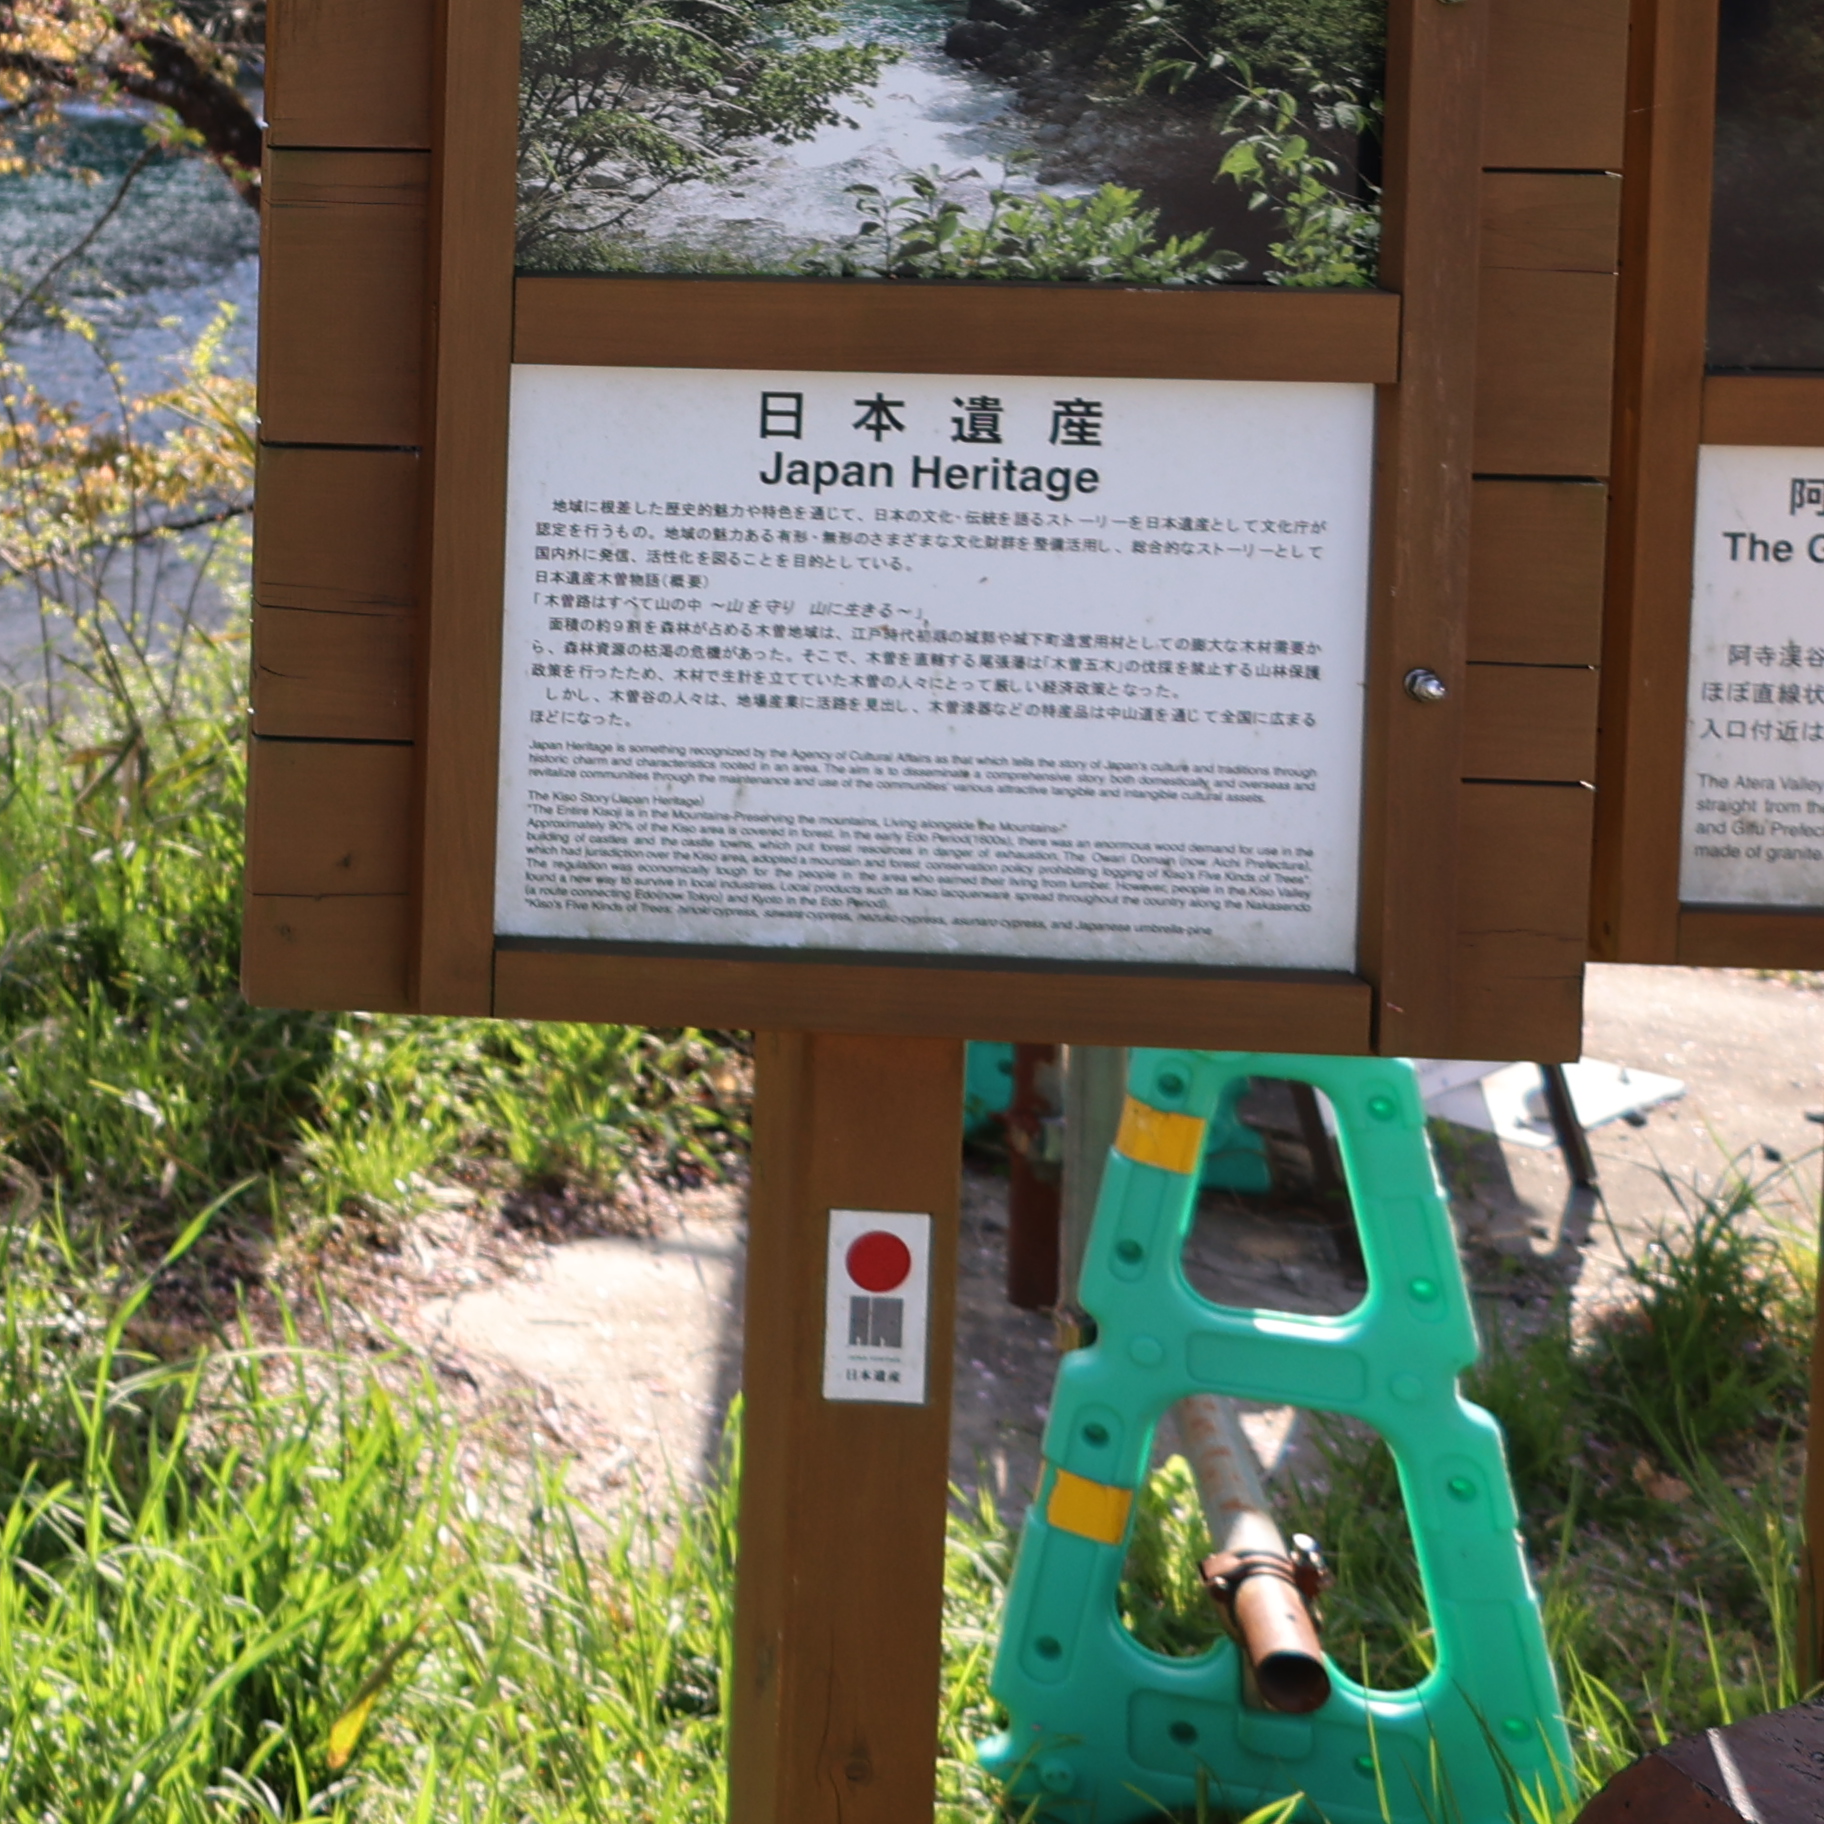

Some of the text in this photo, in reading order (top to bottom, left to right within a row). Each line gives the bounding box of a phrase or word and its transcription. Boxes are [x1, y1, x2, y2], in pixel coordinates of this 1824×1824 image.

[758, 390, 1104, 447] 日本遺産
[758, 451, 1101, 502] Japan Heritage
[1722, 531, 1794, 563] The
